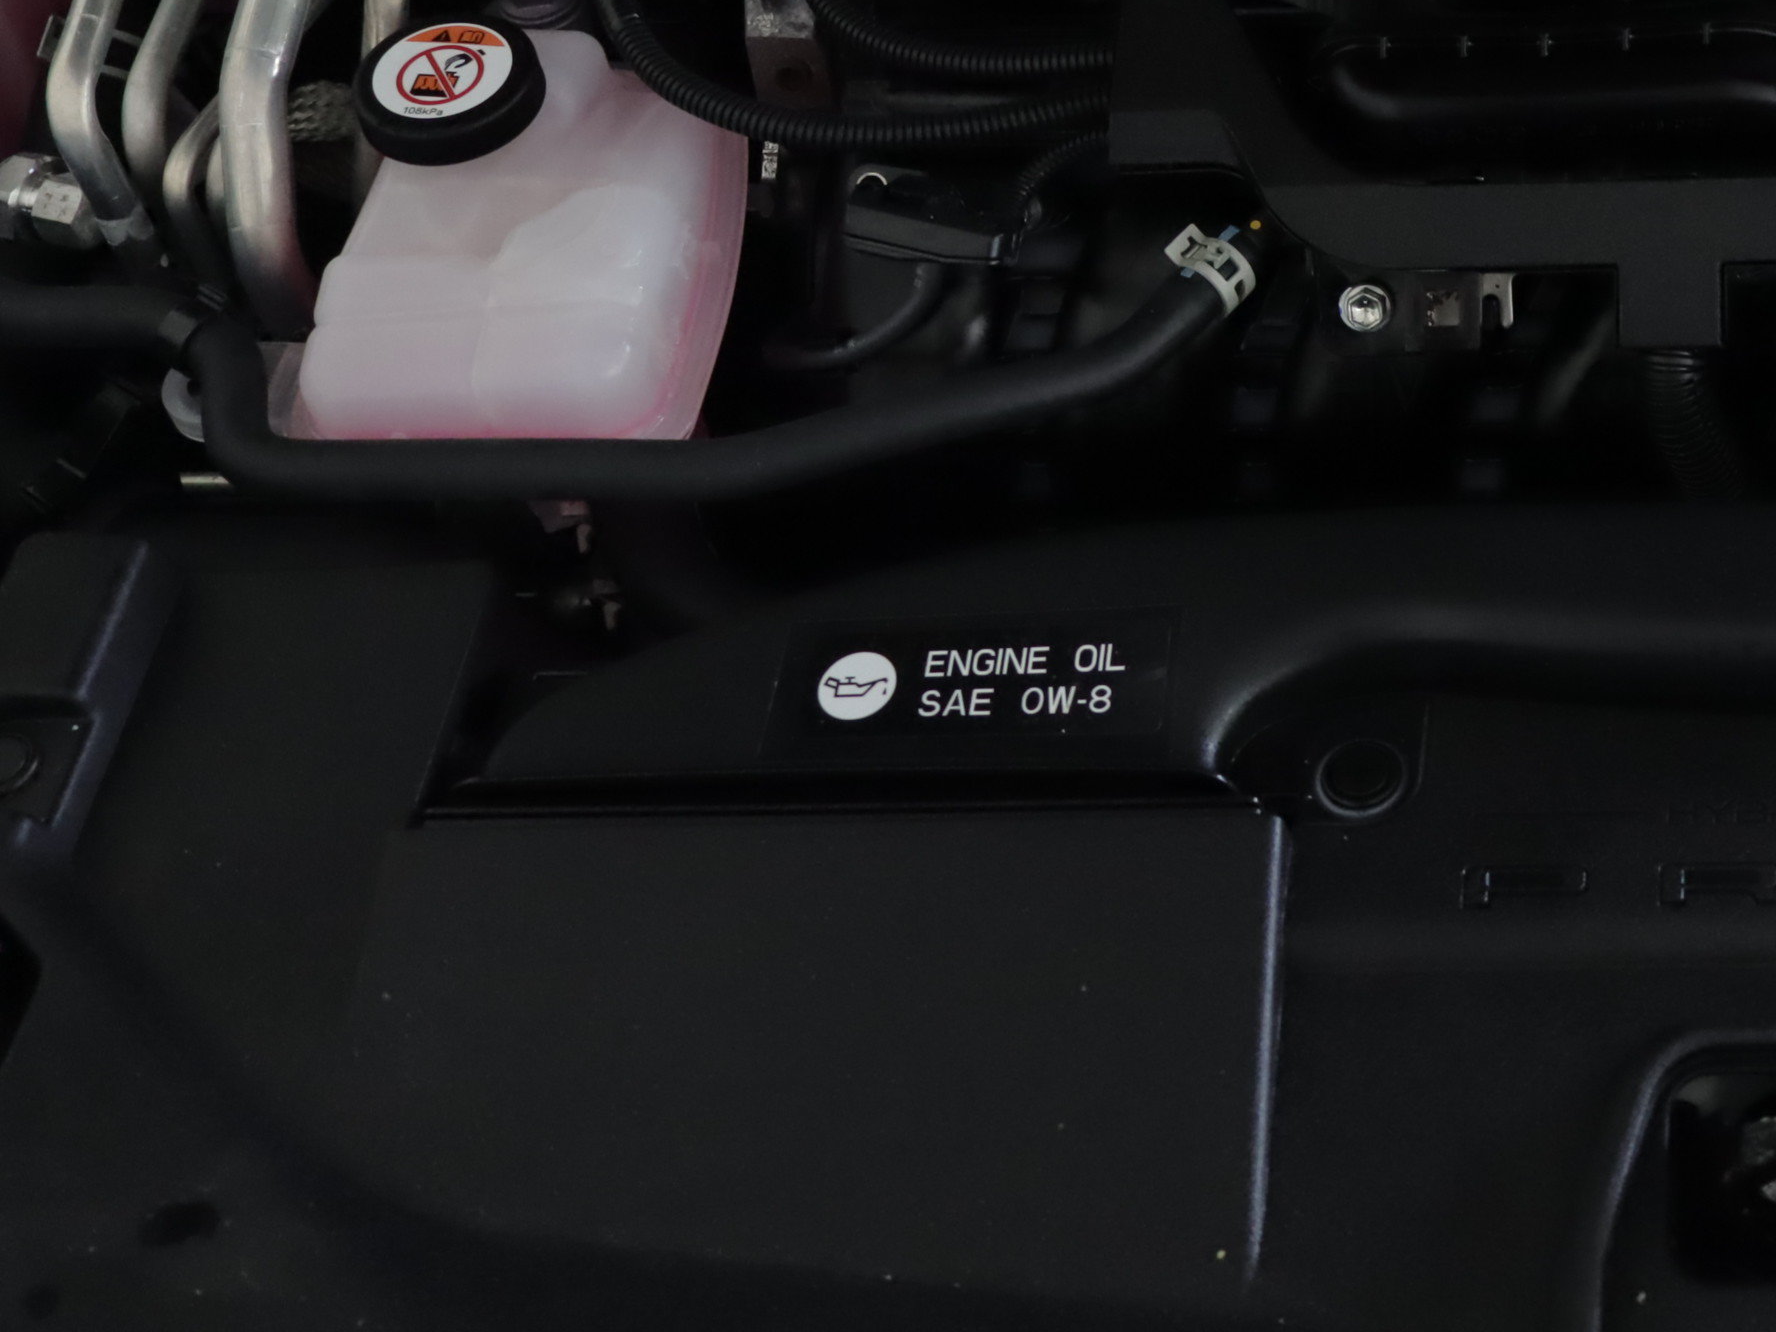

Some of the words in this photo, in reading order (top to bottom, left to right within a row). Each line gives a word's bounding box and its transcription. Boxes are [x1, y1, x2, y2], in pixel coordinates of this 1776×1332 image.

[402, 106, 444, 116] 108kPa
[923, 645, 1051, 679] ENGINE
[1073, 642, 1127, 674] OIL
[917, 687, 995, 718] SAE
